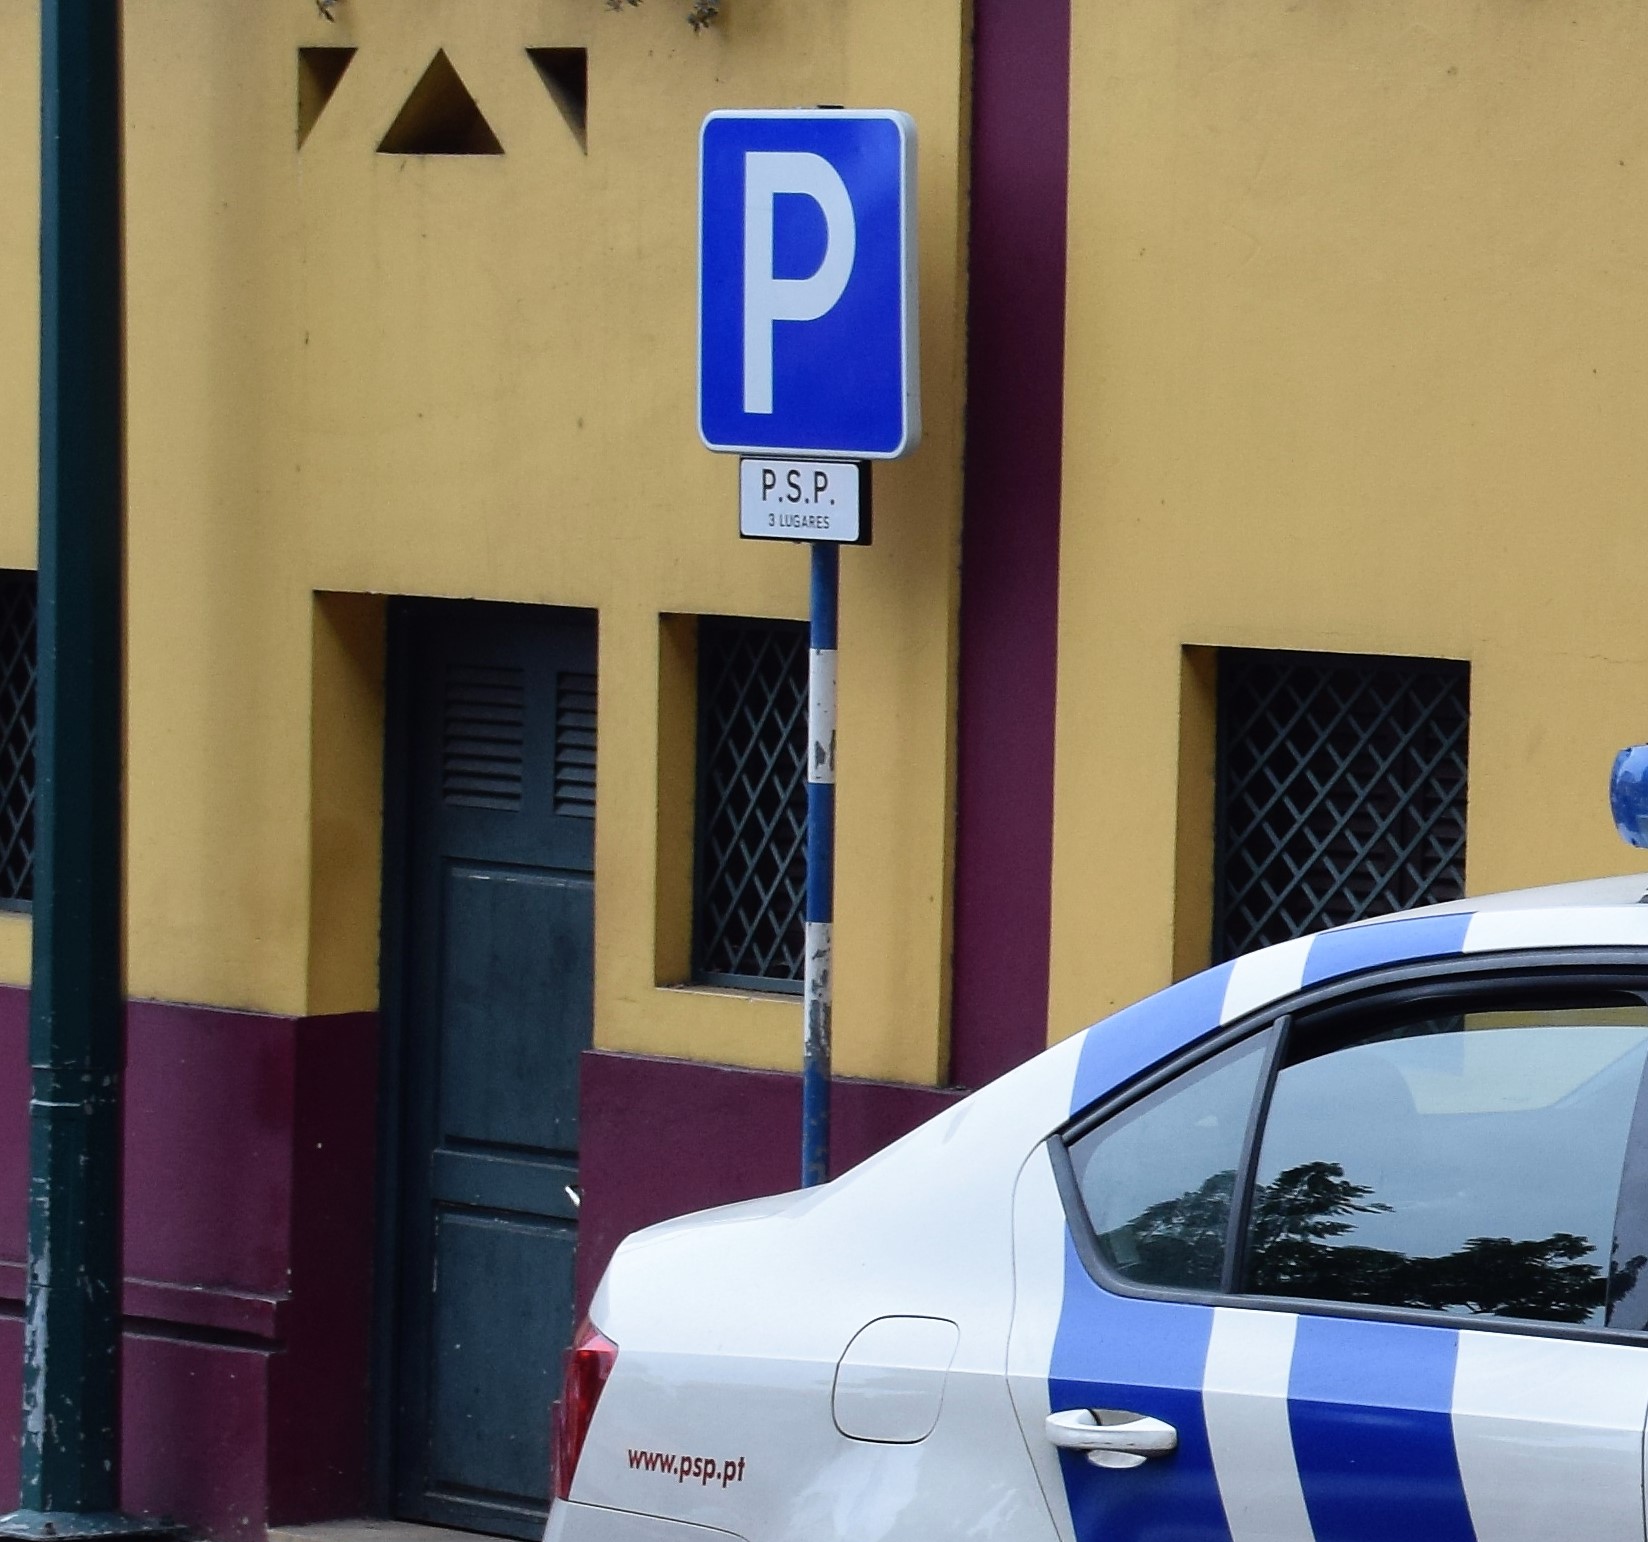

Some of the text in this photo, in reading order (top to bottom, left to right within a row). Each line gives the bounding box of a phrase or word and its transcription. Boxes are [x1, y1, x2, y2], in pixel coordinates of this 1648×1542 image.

[743, 151, 857, 414] P
[761, 468, 835, 505] P.S.P.
[769, 513, 830, 529] 3 LUGARES
[627, 1448, 746, 1488] www.psp.pt
